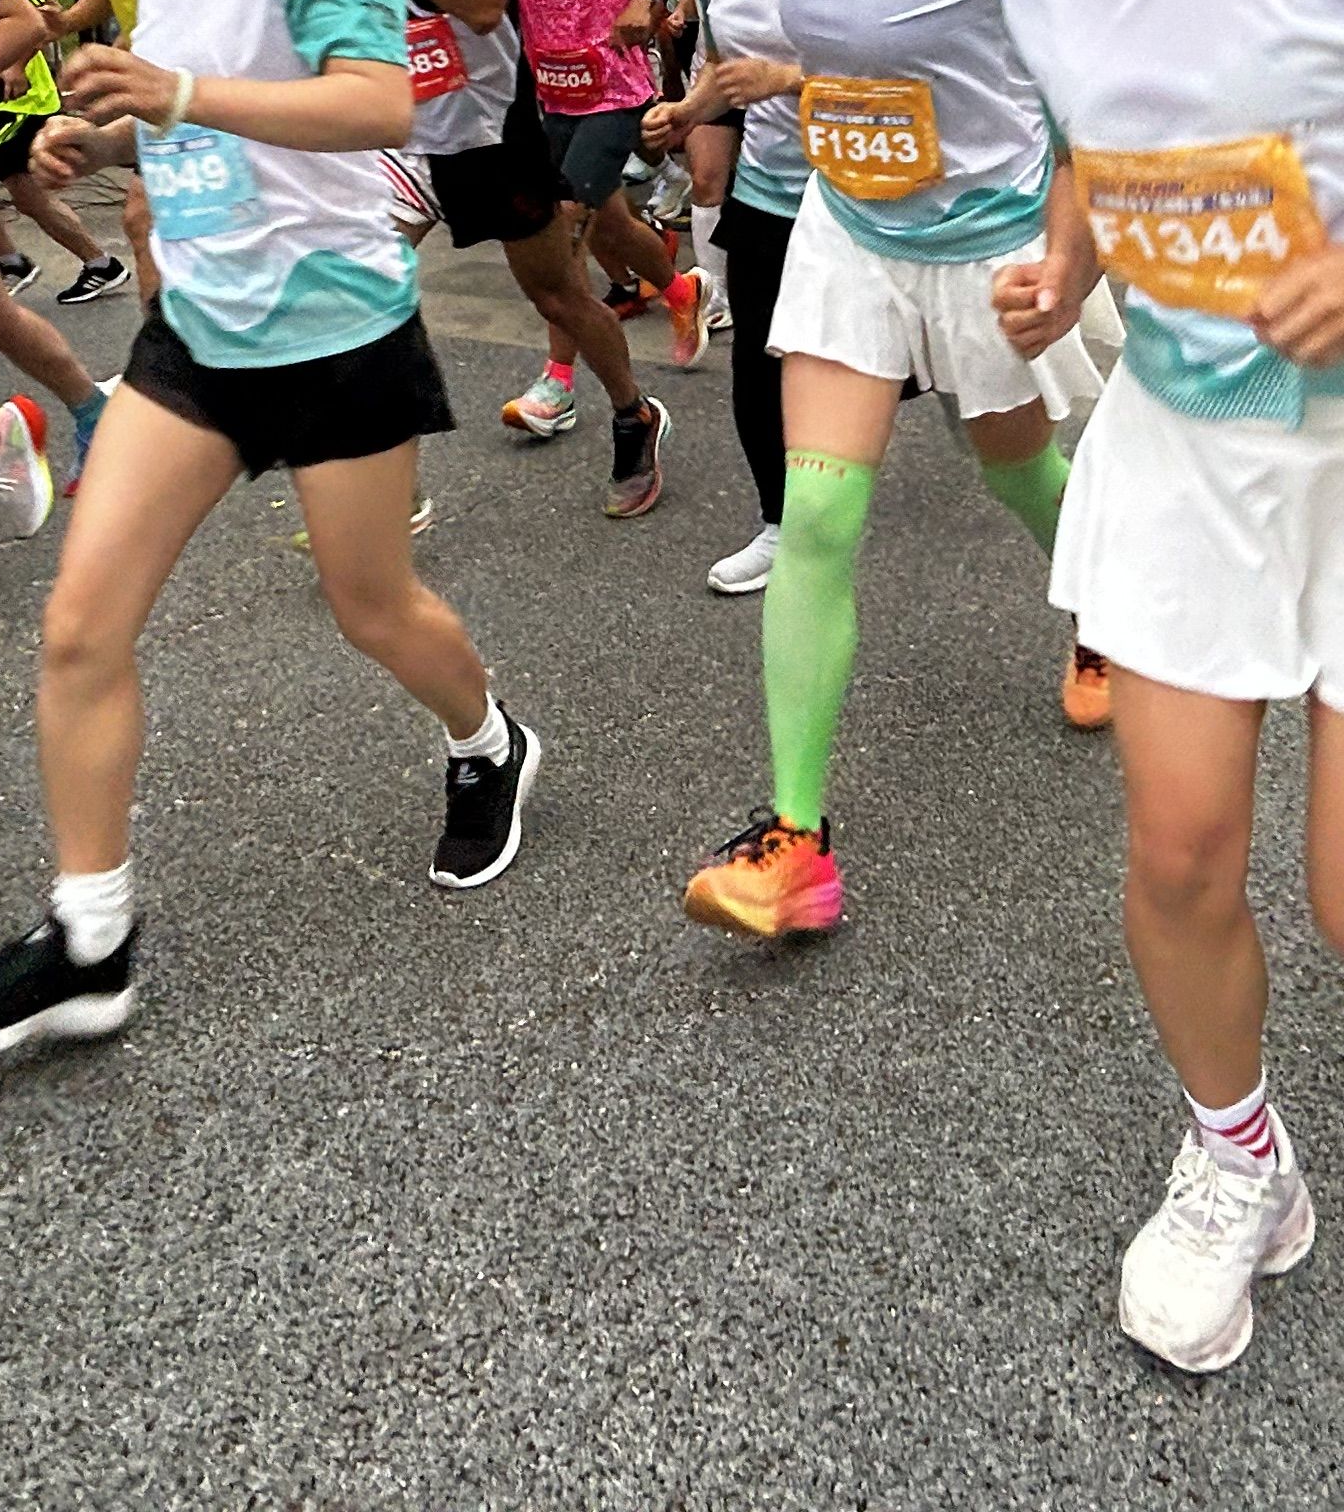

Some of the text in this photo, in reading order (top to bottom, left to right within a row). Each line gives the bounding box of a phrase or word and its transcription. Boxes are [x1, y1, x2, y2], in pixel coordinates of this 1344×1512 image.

[537, 69, 593, 88] M2504
[807, 124, 920, 164] F1343
[1088, 210, 1290, 265] F1344
